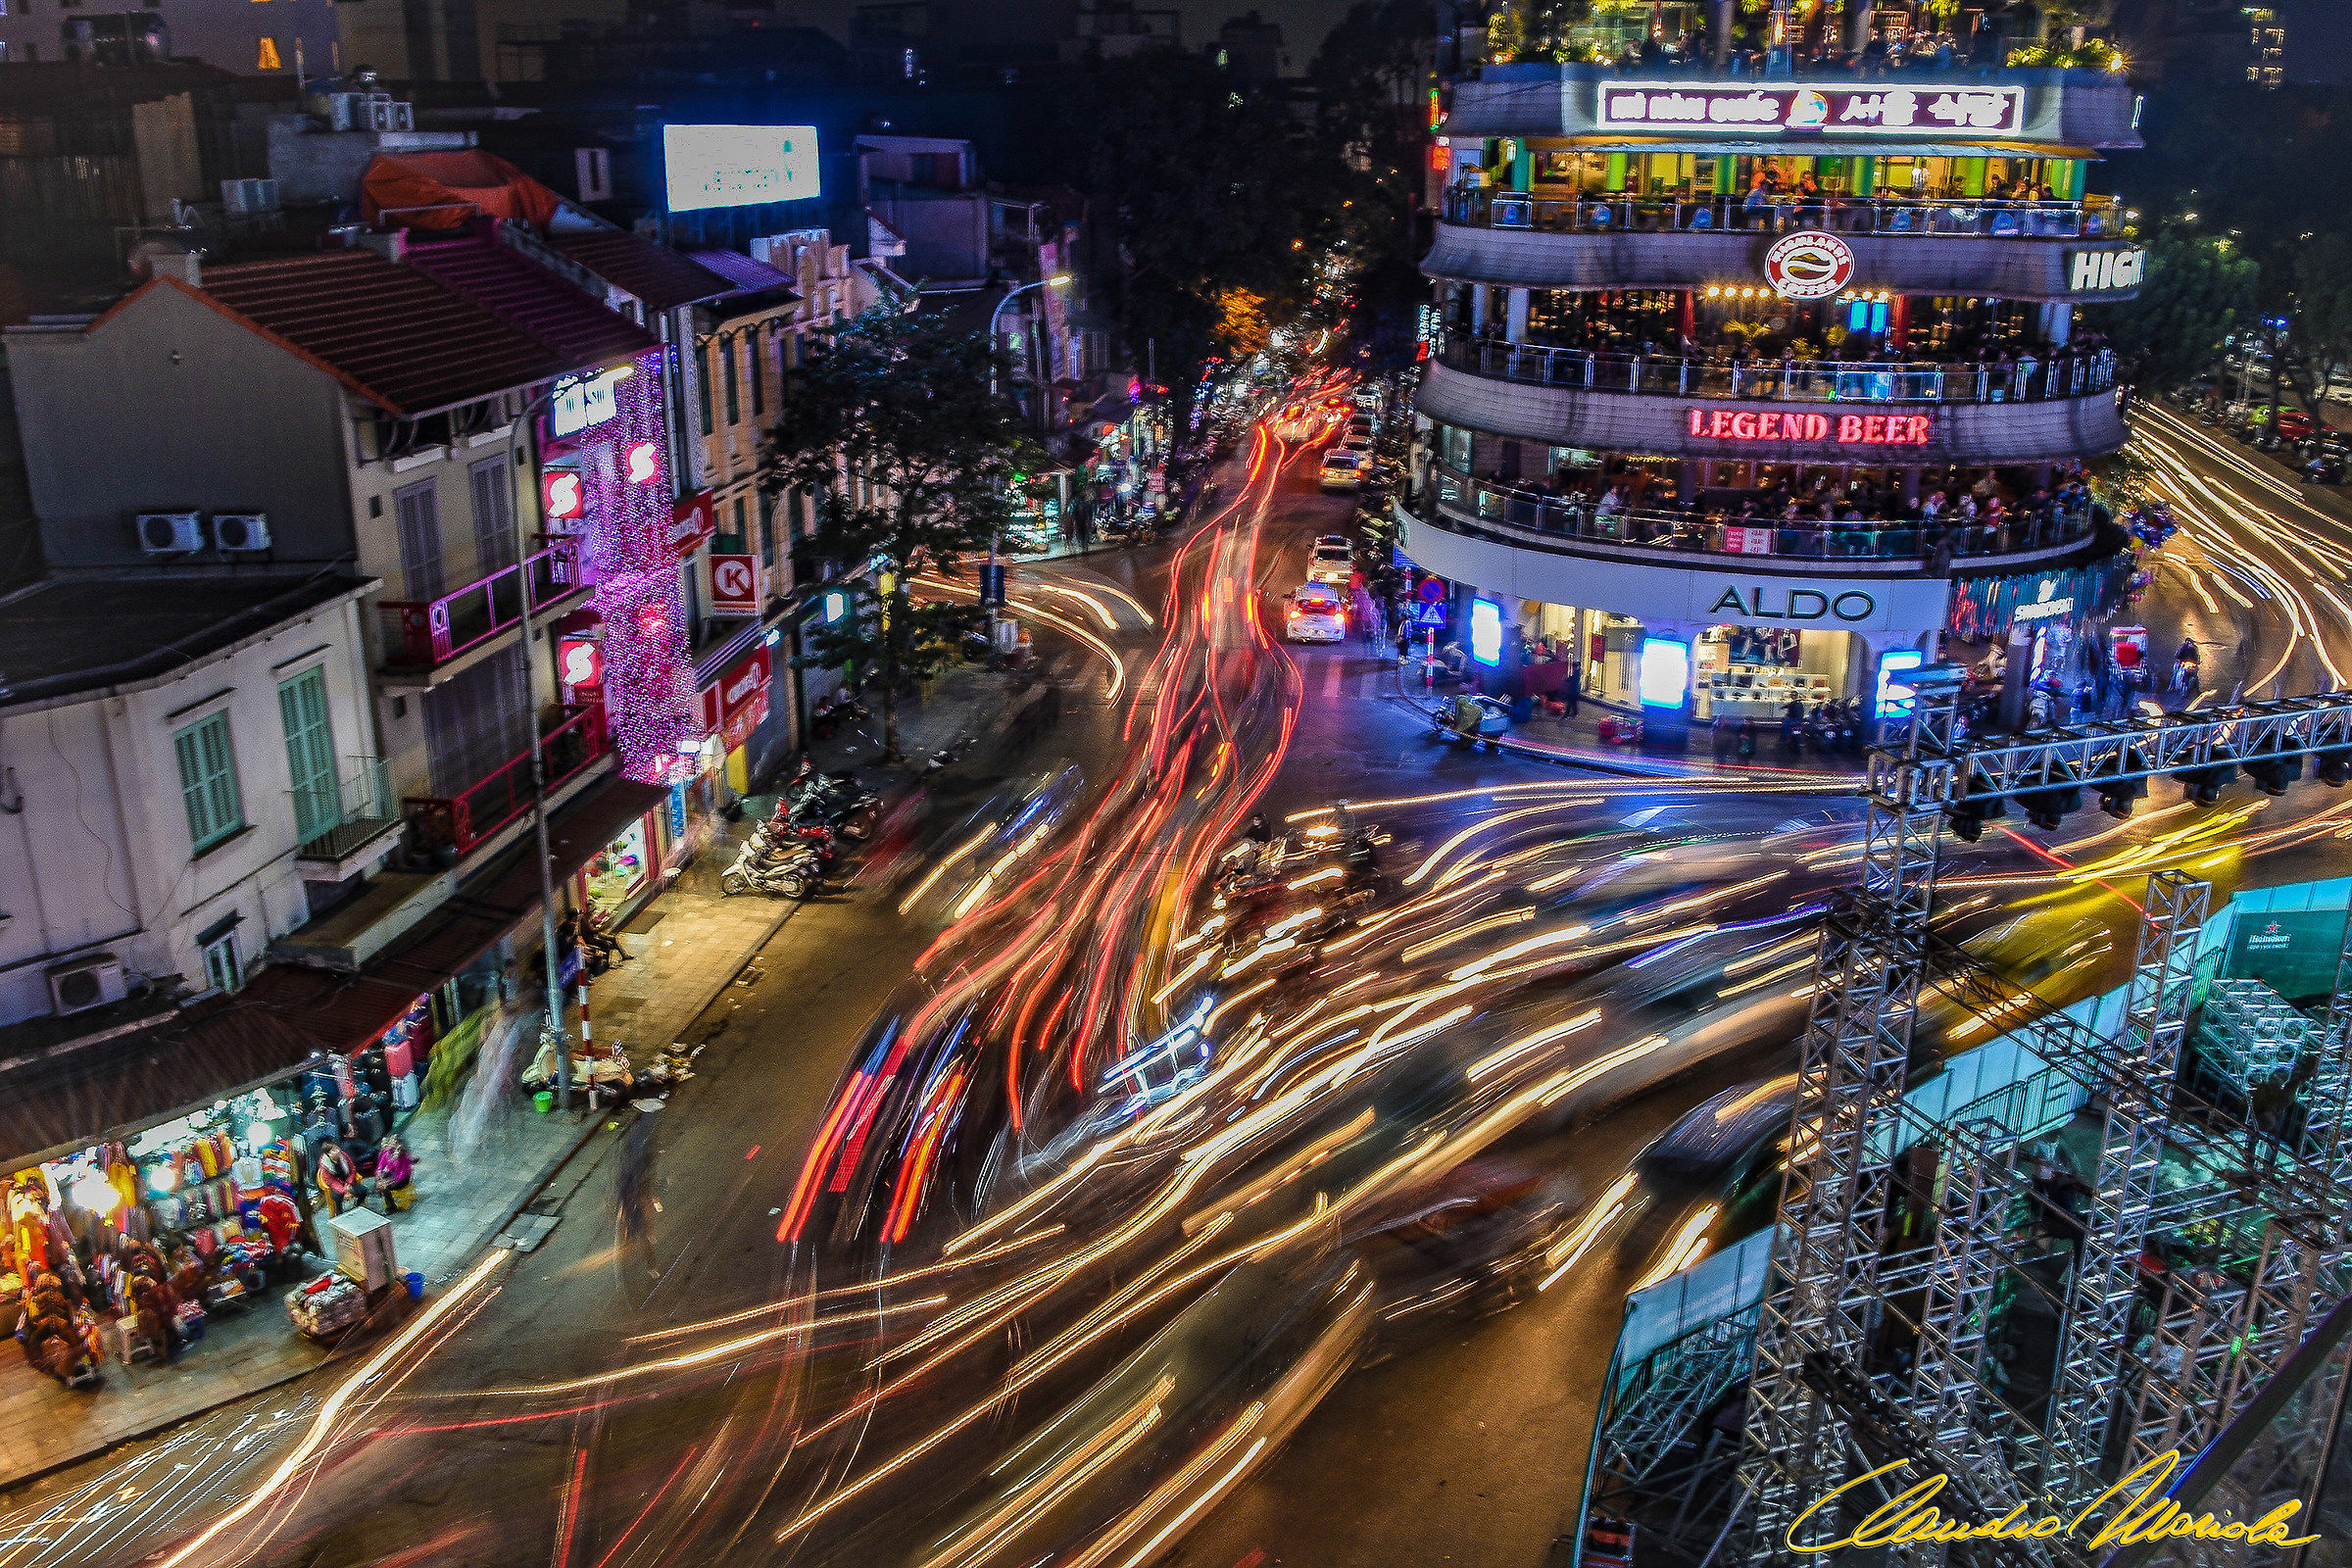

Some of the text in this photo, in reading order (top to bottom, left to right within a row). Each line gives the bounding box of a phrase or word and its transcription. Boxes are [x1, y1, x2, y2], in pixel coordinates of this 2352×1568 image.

[1690, 409, 1929, 444] LEGEND BEER
[1707, 584, 1877, 622] ALDO
